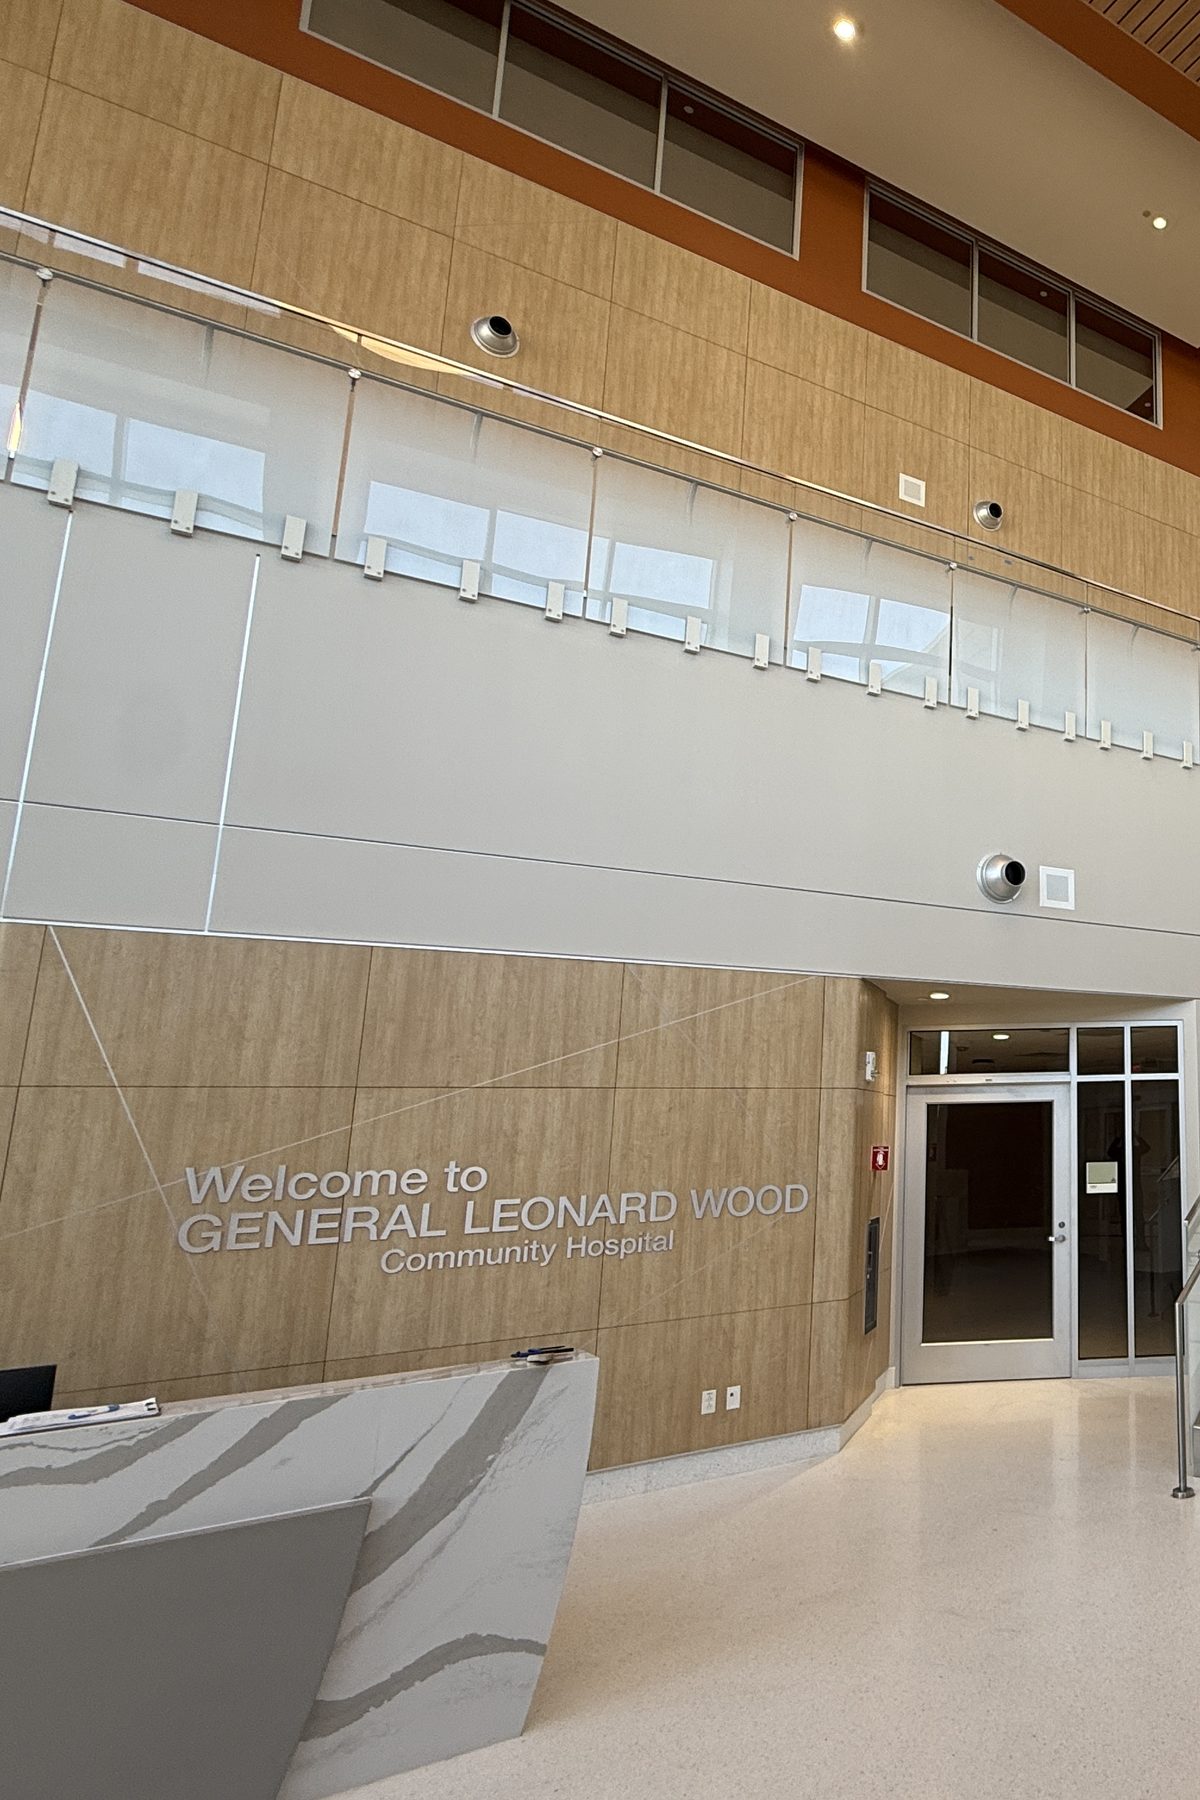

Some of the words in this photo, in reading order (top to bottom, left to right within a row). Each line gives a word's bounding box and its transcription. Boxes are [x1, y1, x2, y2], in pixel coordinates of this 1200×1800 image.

[185, 1164, 429, 1205] Welcome
[443, 1160, 488, 1193] to
[177, 1203, 447, 1254] GENERAL
[463, 1190, 678, 1235] LEONARD
[690, 1183, 809, 1219] WOOD
[380, 1239, 557, 1274] Community
[566, 1230, 675, 1260] Hospital
